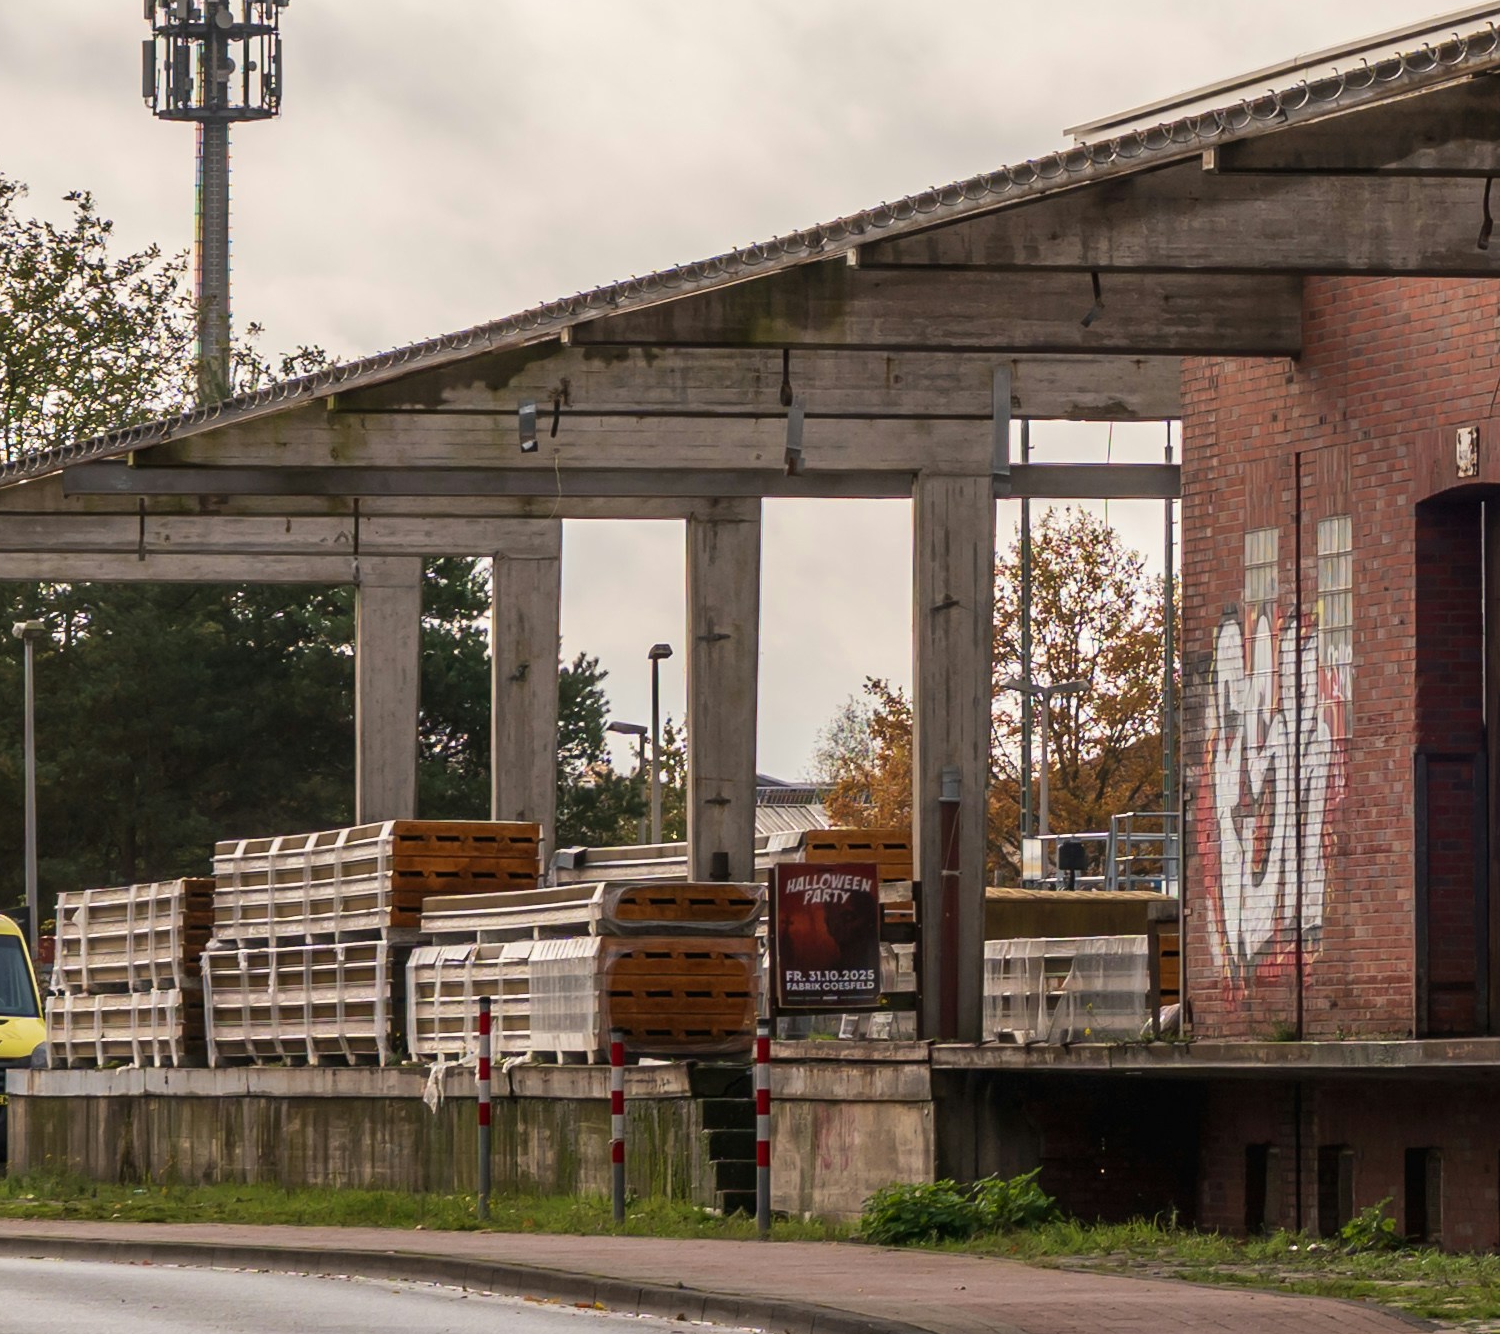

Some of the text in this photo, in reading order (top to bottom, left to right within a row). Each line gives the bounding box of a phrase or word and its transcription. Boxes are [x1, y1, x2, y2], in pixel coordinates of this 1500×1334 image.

[786, 873, 872, 893] HALLOWEEN
[803, 889, 851, 905] PARTY
[786, 969, 875, 981] FR. 31.10.2025
[786, 981, 875, 990] FABRIK COESFELD
